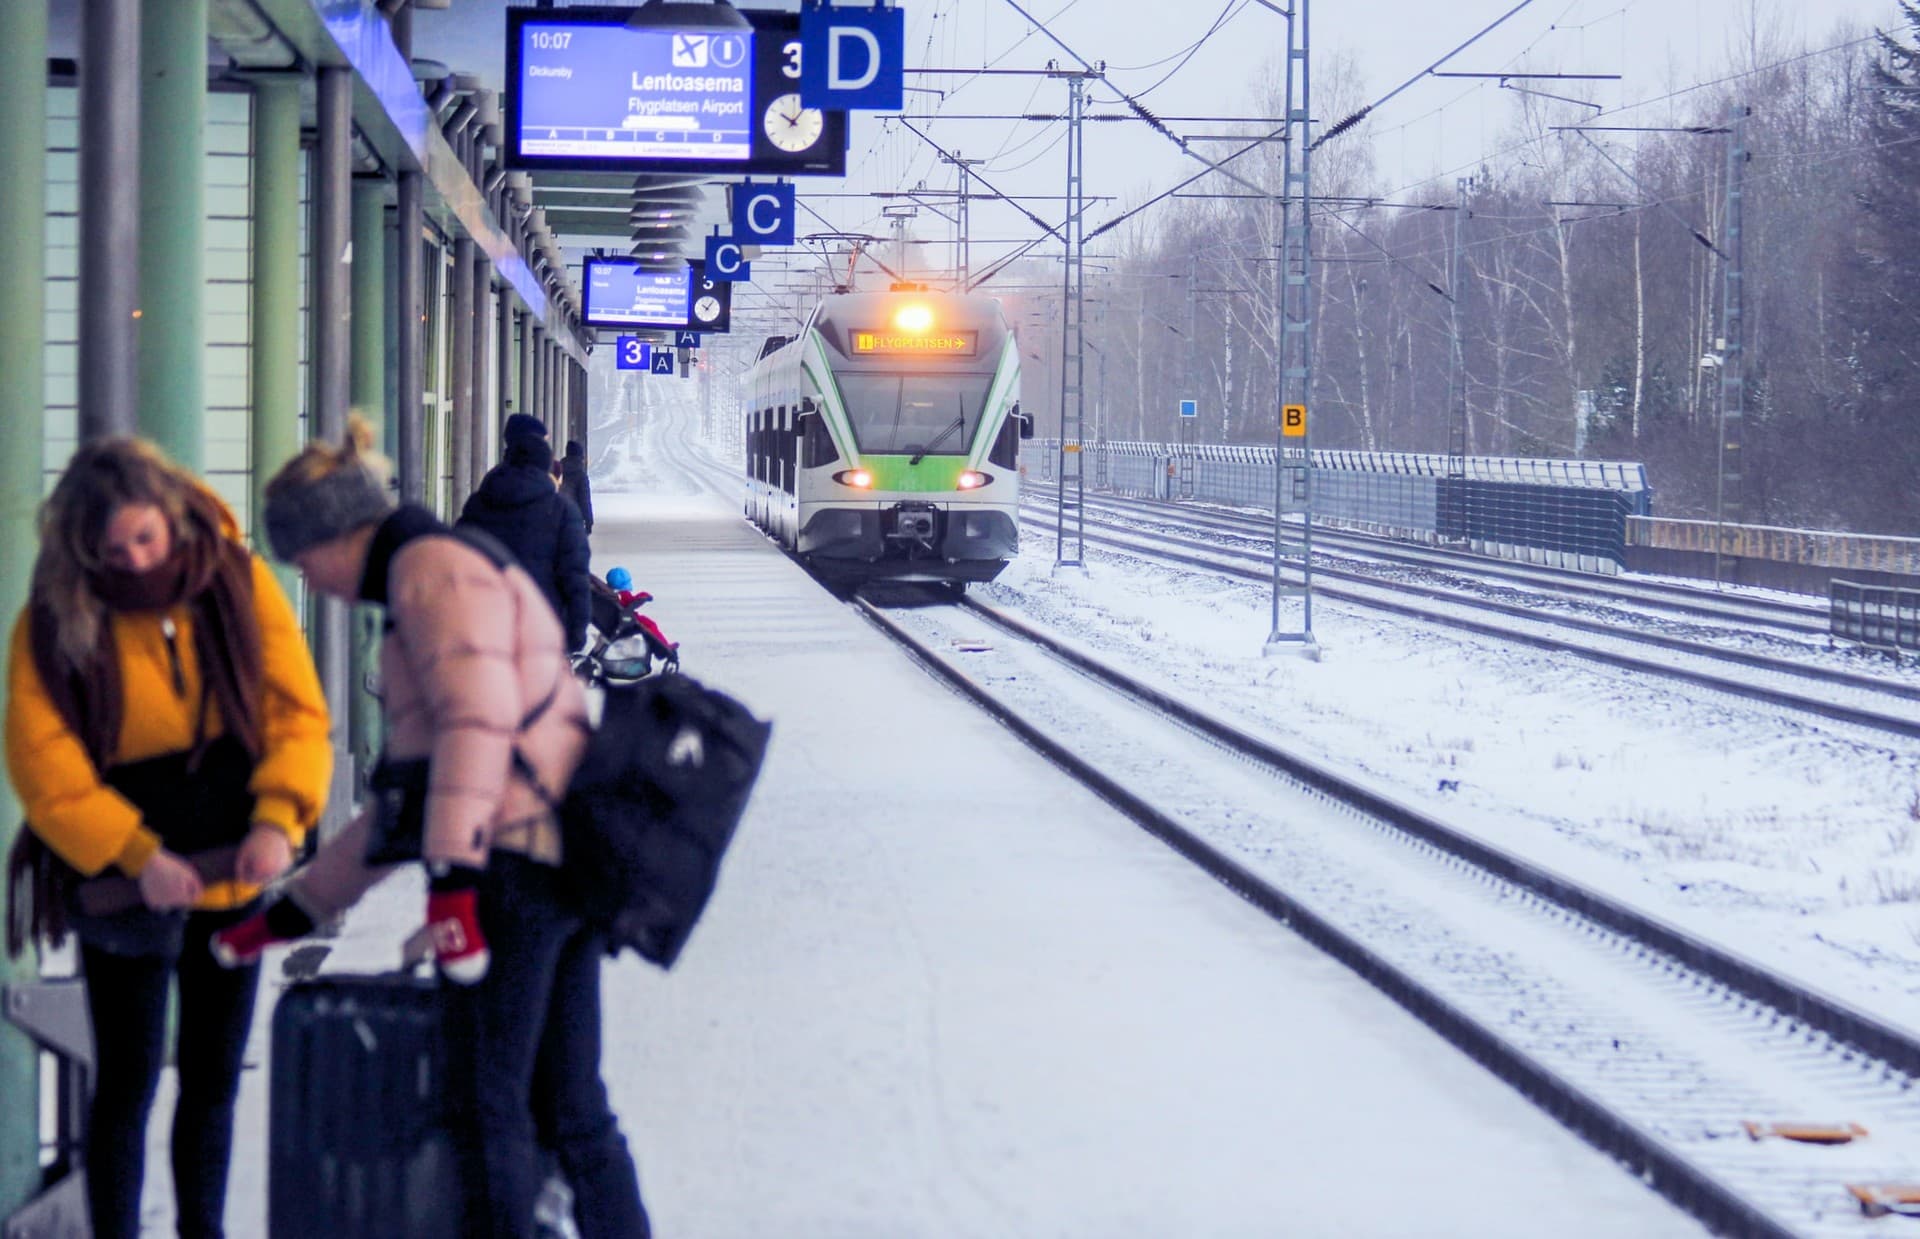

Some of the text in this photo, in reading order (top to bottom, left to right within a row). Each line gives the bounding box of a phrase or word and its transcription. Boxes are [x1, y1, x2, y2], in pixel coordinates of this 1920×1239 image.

[531, 31, 573, 49] 10:07
[782, 42, 802, 78] 3
[827, 26, 881, 90] D
[632, 71, 744, 93] Lentoasema
[628, 97, 744, 117] Flygplatsen Airport
[548, 129, 558, 139] A
[656, 131, 665, 141] C
[747, 194, 781, 235] C
[715, 244, 741, 273] C
[680, 331, 695, 344] A
[625, 341, 642, 364] 3
[656, 356, 669, 371] A
[1286, 408, 1301, 426] B
